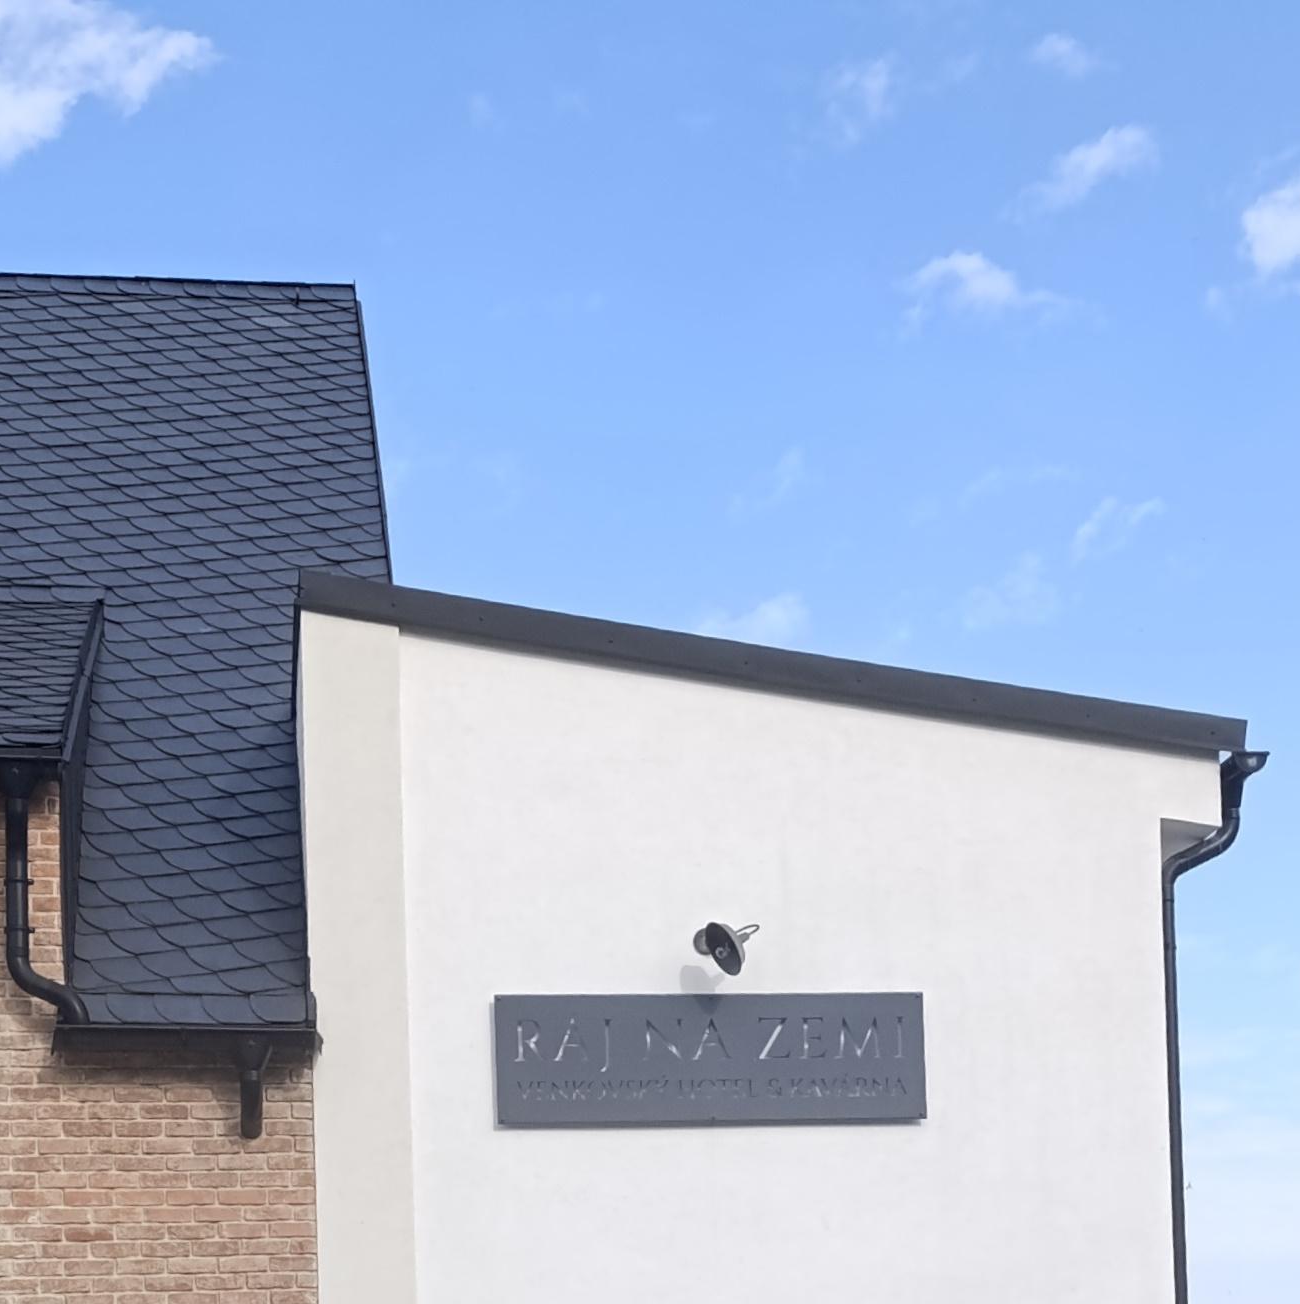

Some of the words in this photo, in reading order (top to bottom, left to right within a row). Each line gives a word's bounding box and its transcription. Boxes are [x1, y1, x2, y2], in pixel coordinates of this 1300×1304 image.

[641, 1016, 732, 1062] NA
[757, 1015, 906, 1061] ZEMI
[516, 1074, 669, 1102] VENKOVSKÝ
[677, 1077, 757, 1101] HOTEL
[766, 1077, 783, 1099] &
[789, 1073, 908, 1099] KAVÁRNA
